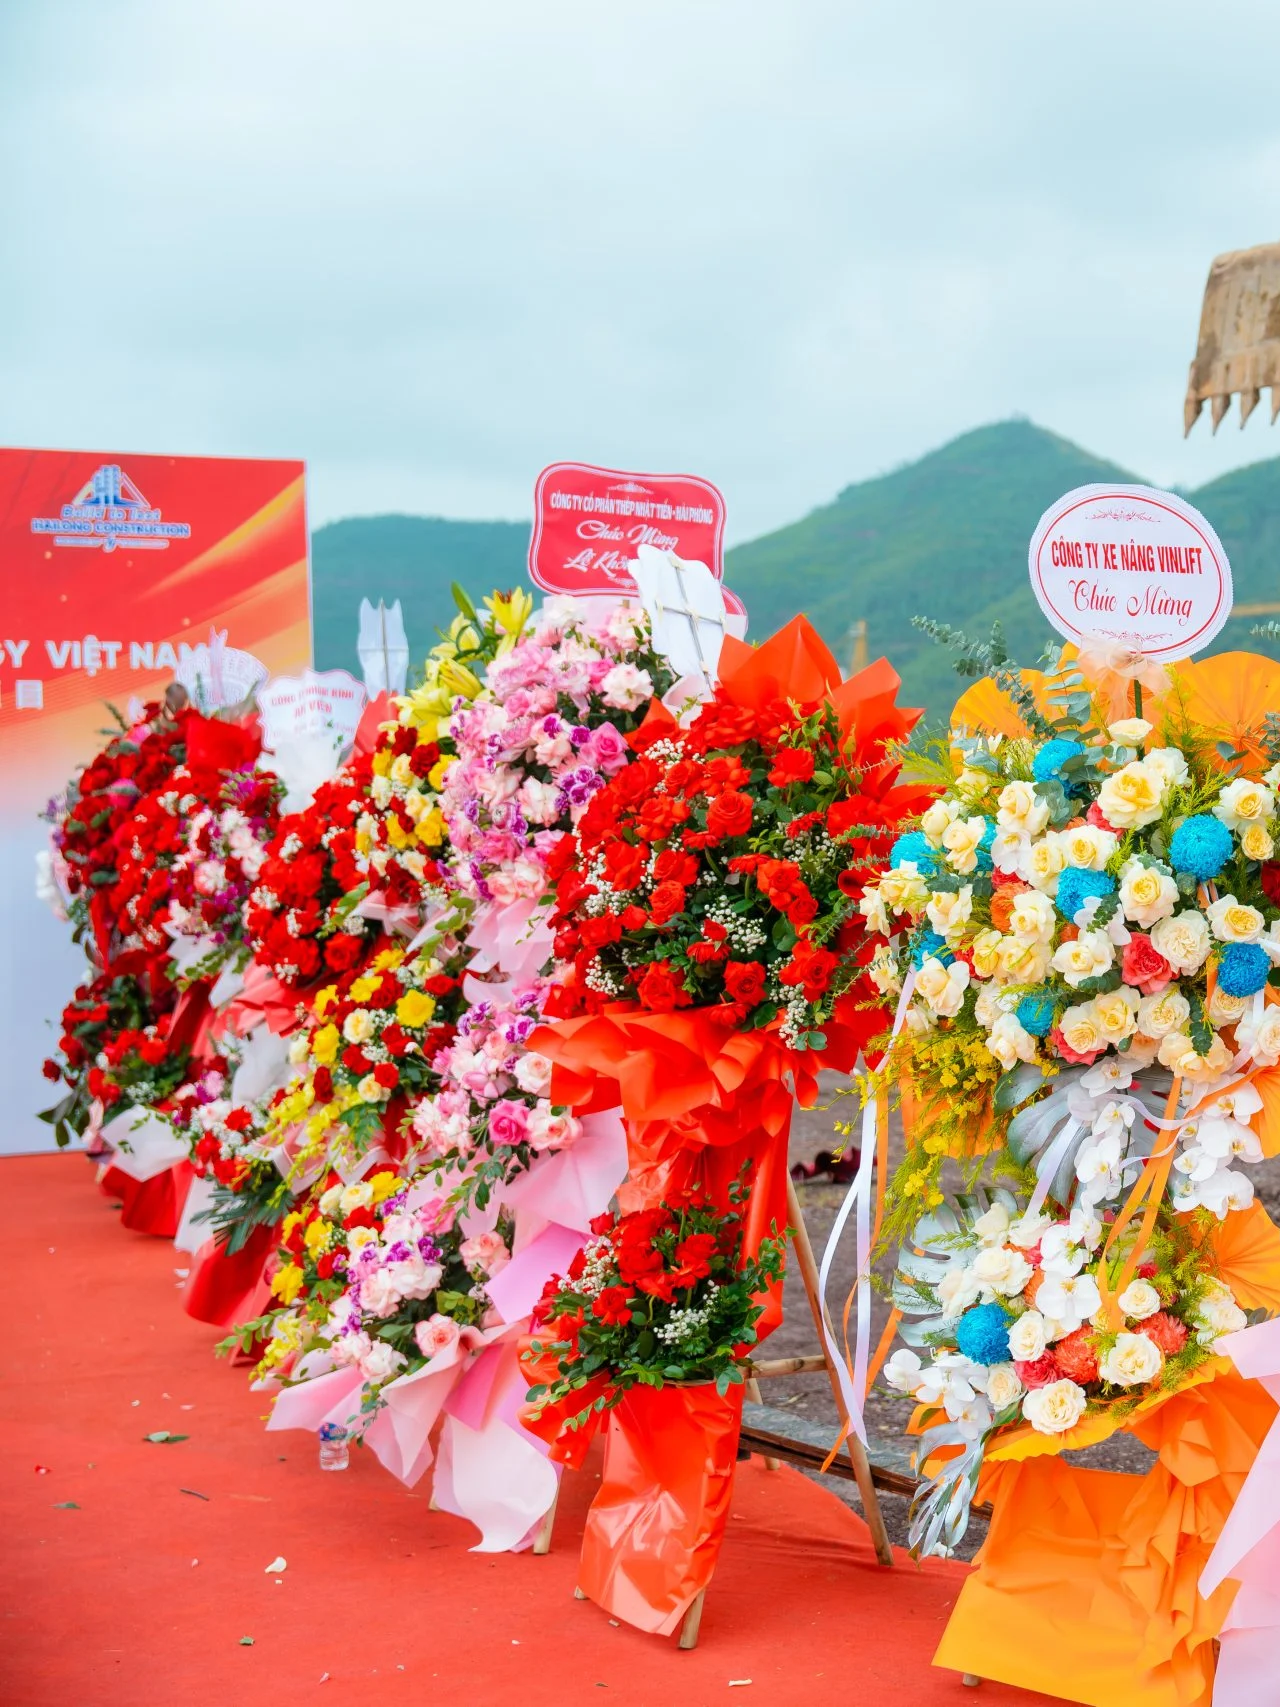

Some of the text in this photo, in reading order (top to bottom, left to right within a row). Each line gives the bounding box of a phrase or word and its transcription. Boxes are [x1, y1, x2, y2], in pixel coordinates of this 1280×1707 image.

[550, 489, 571, 509] CÔNG
[572, 494, 583, 510] TY
[95, 521, 190, 538] CONSTRUCTION
[576, 519, 624, 541] Chúc
[1051, 535, 1203, 574] CÔNG TY XE NÂNG VINLIFT
[1068, 578, 1193, 626] Chúc Mừng
[45, 634, 122, 677] VIỆT
